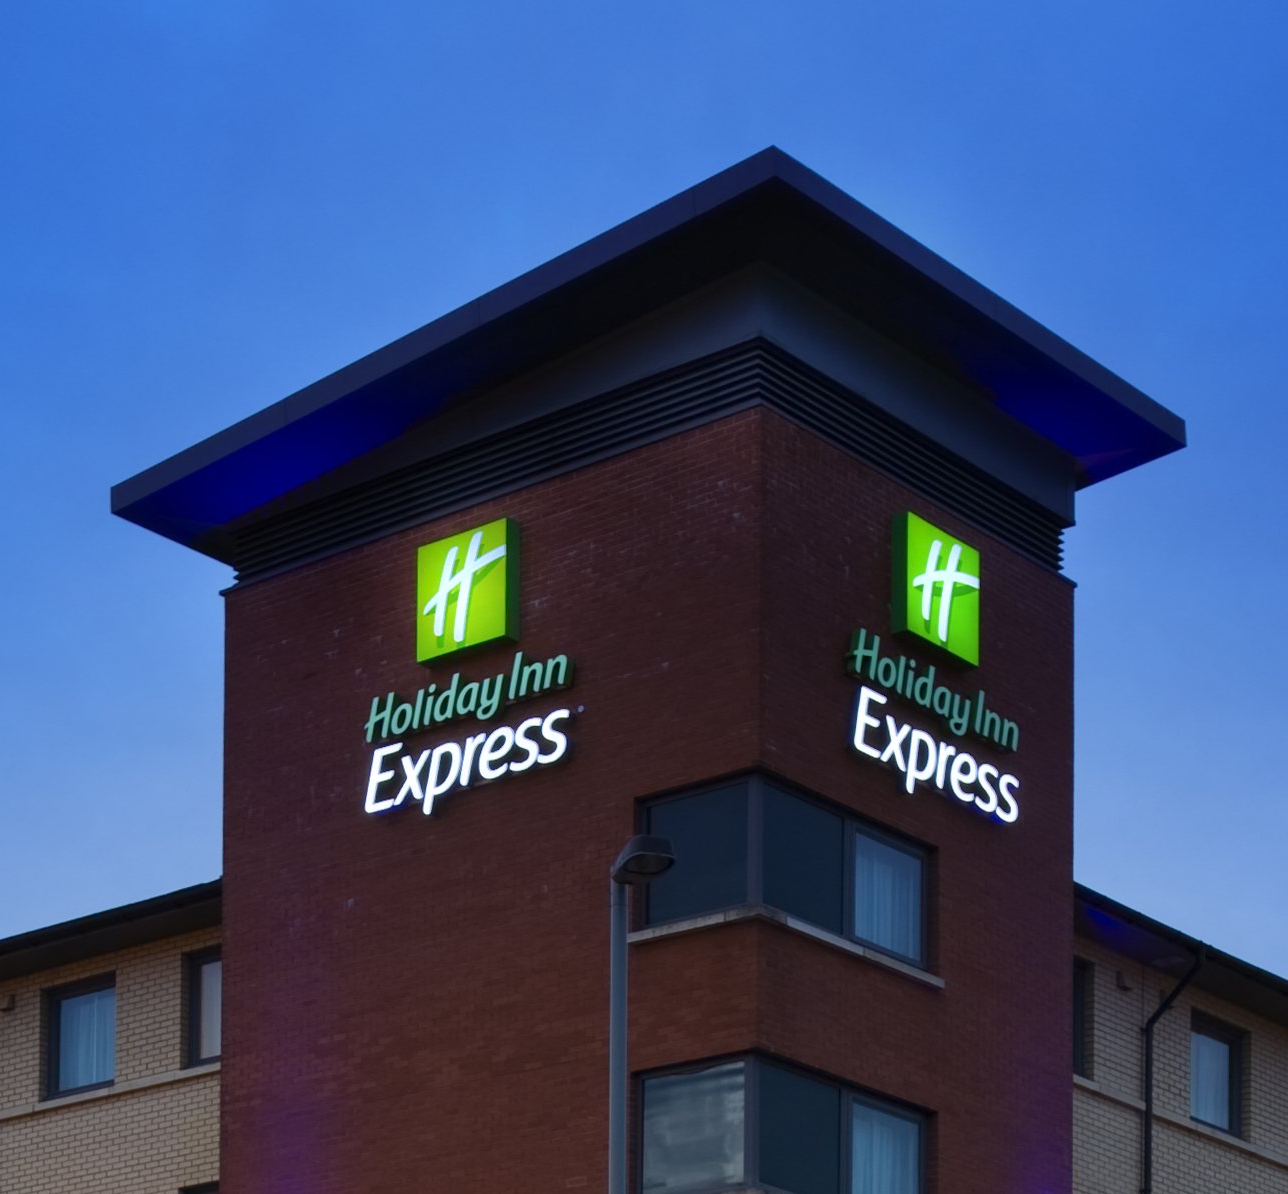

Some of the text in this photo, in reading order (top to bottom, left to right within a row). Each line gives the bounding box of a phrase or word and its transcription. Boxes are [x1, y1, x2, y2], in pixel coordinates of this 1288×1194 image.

[363, 651, 568, 743] Holiday Inn
[852, 627, 1019, 752] Holiday Inn
[363, 708, 570, 815] Express
[853, 685, 1020, 823] Express
